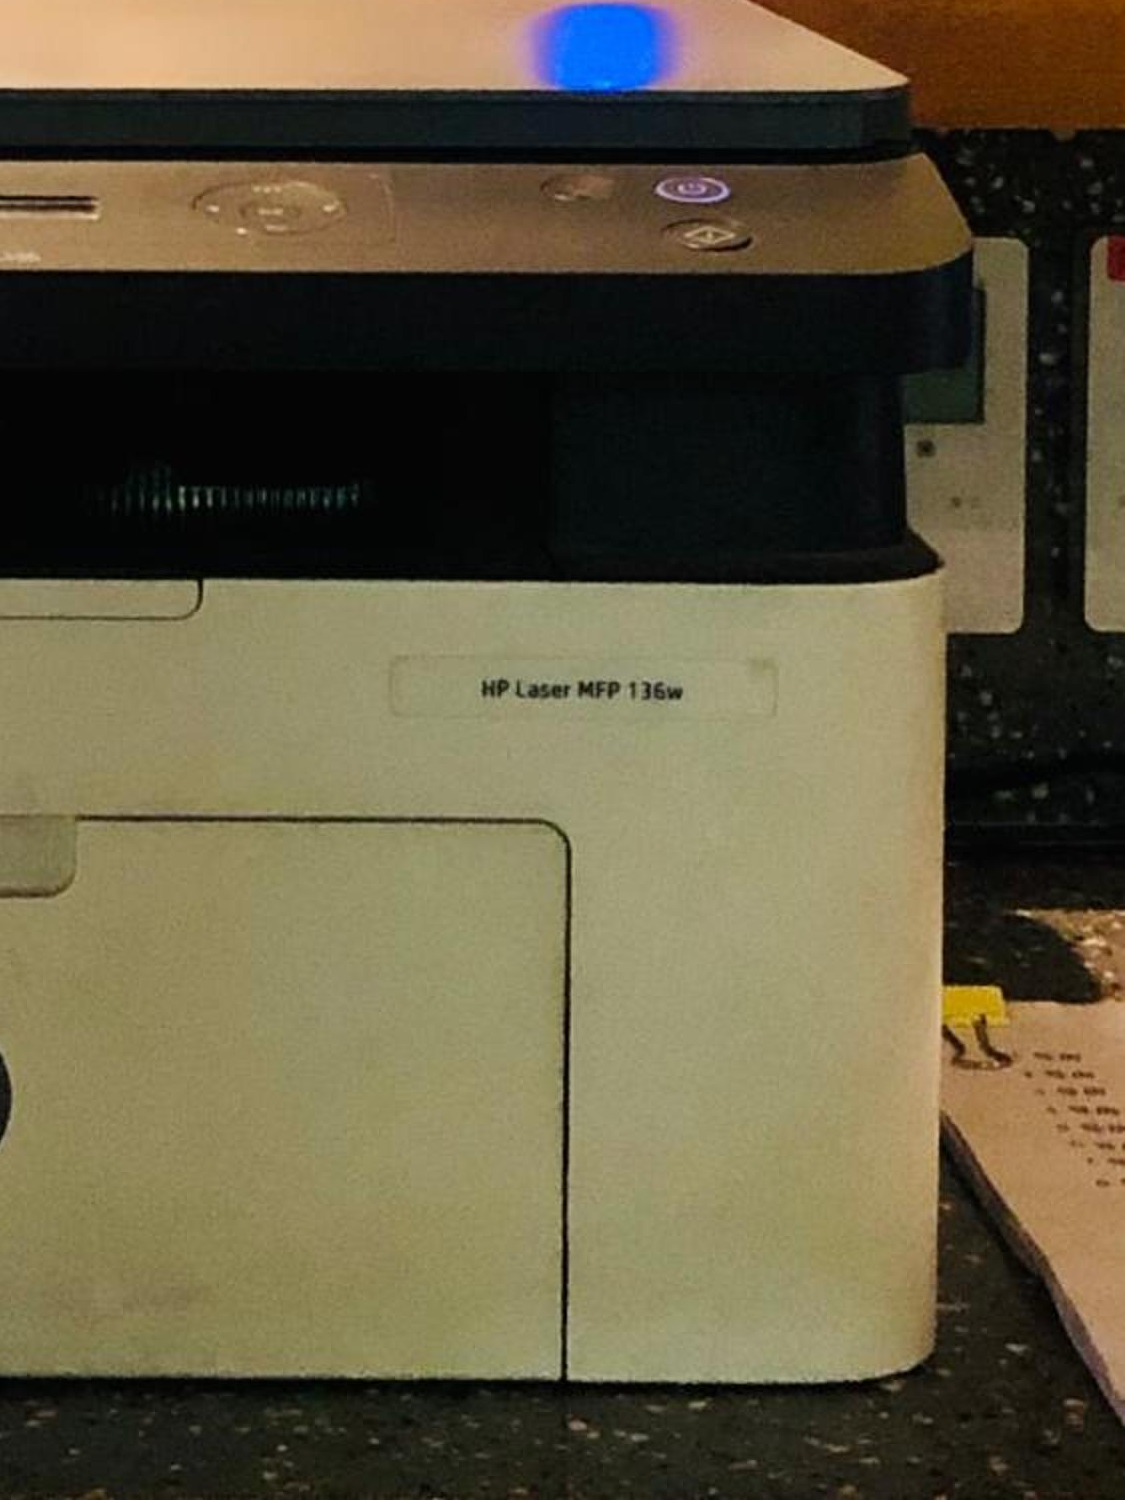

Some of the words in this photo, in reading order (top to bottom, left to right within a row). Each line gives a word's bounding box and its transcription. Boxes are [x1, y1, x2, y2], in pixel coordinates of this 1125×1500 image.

[481, 679, 510, 697] HP
[515, 679, 571, 699] Laser
[577, 680, 620, 699] MFP
[628, 681, 683, 701] 136w
